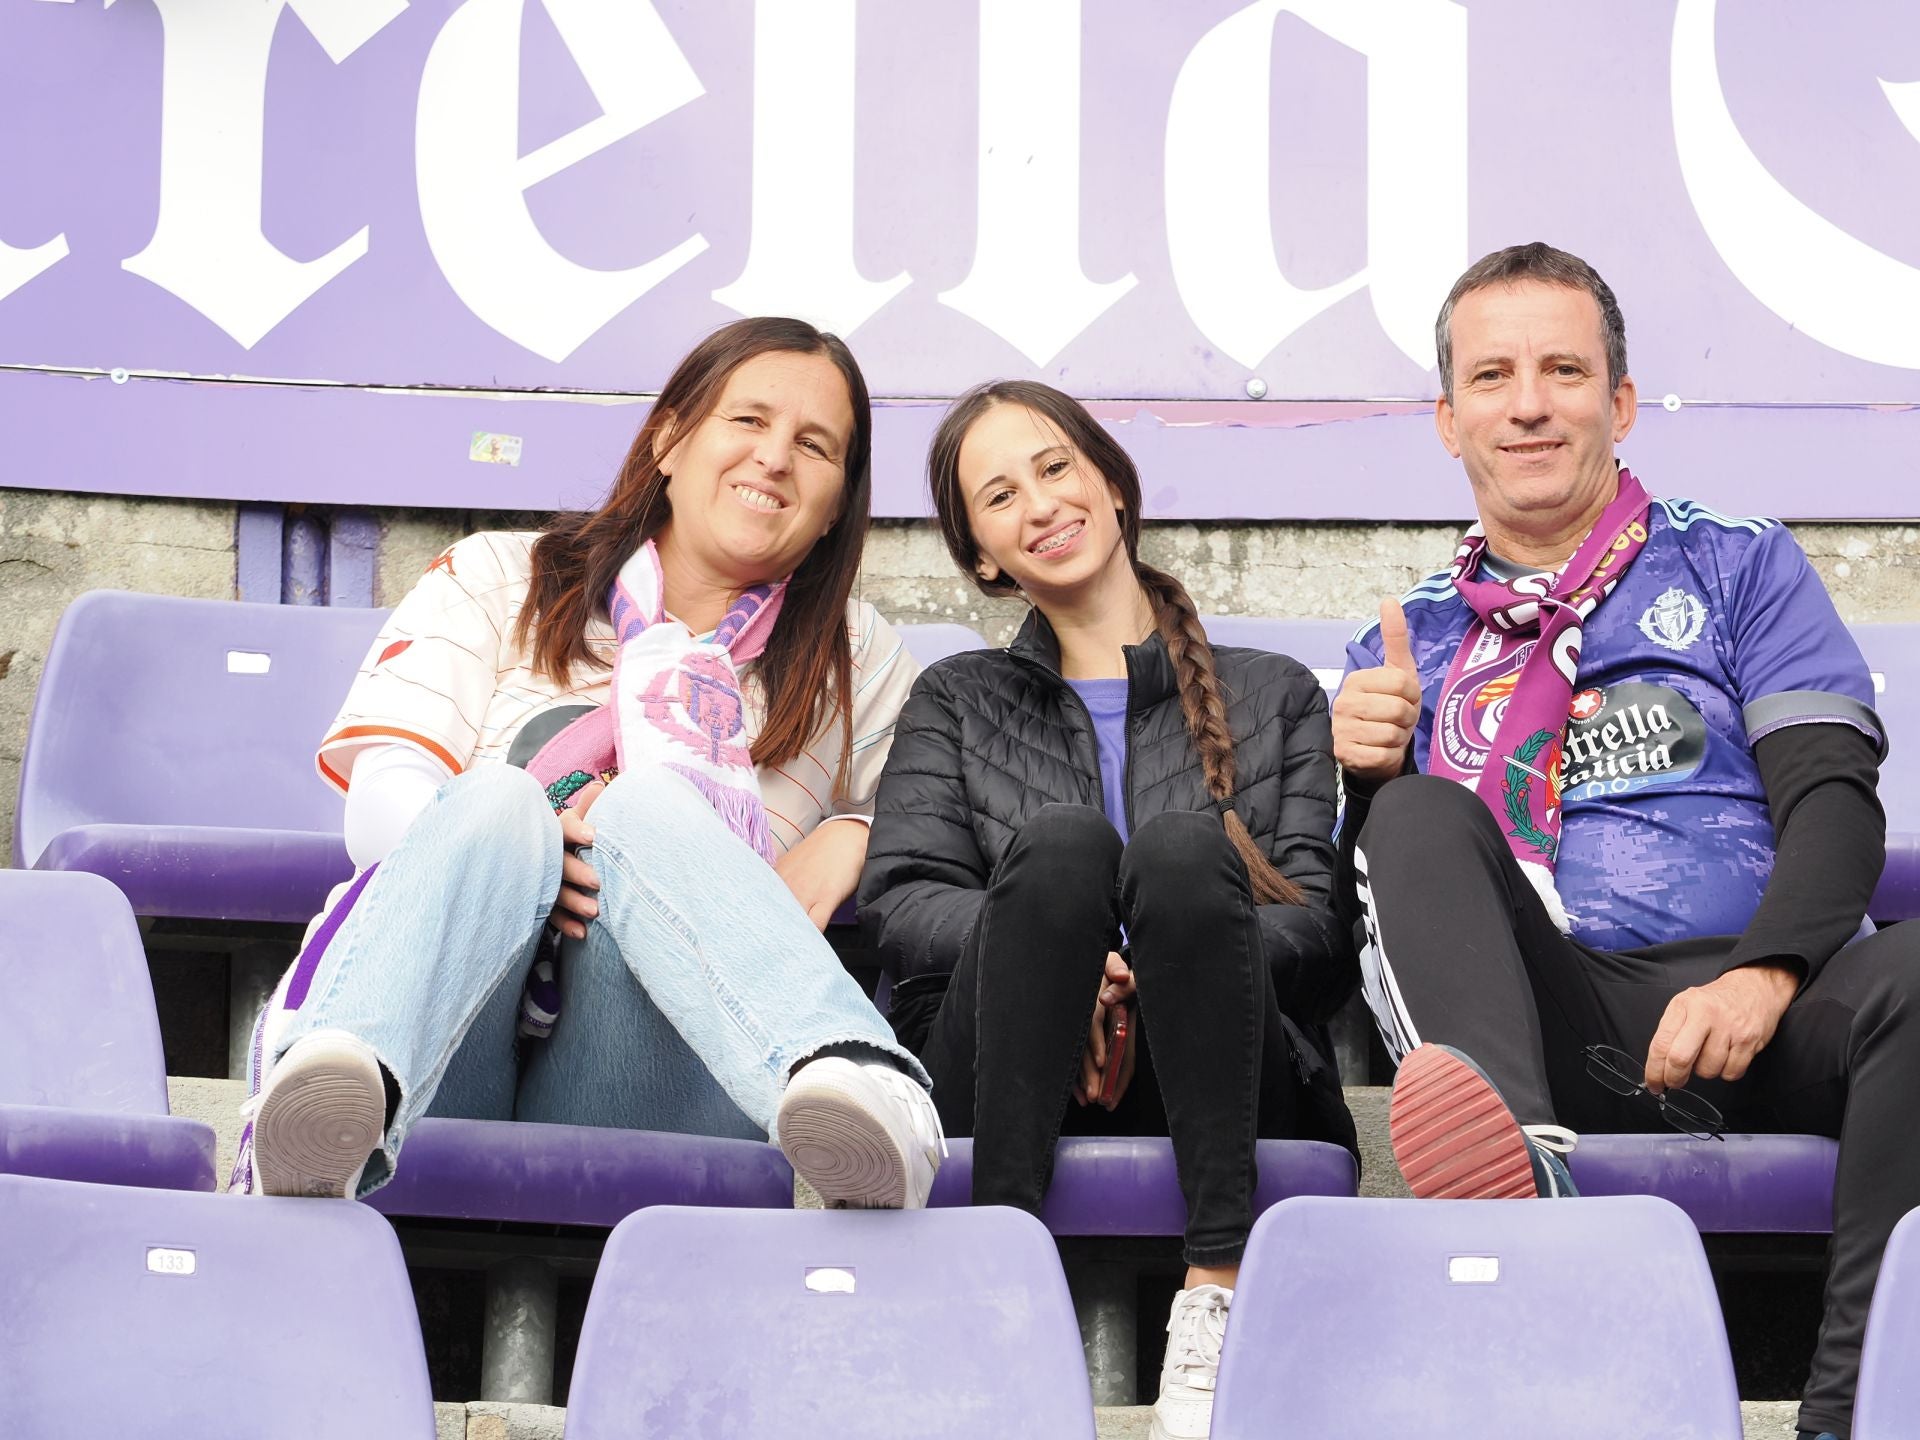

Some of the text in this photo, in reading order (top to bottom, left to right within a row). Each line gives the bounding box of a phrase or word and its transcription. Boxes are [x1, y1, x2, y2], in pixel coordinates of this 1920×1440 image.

[0, 0, 1468, 371] rella
[1465, 751, 1489, 766] Peñ
[158, 1254, 184, 1271] 133
